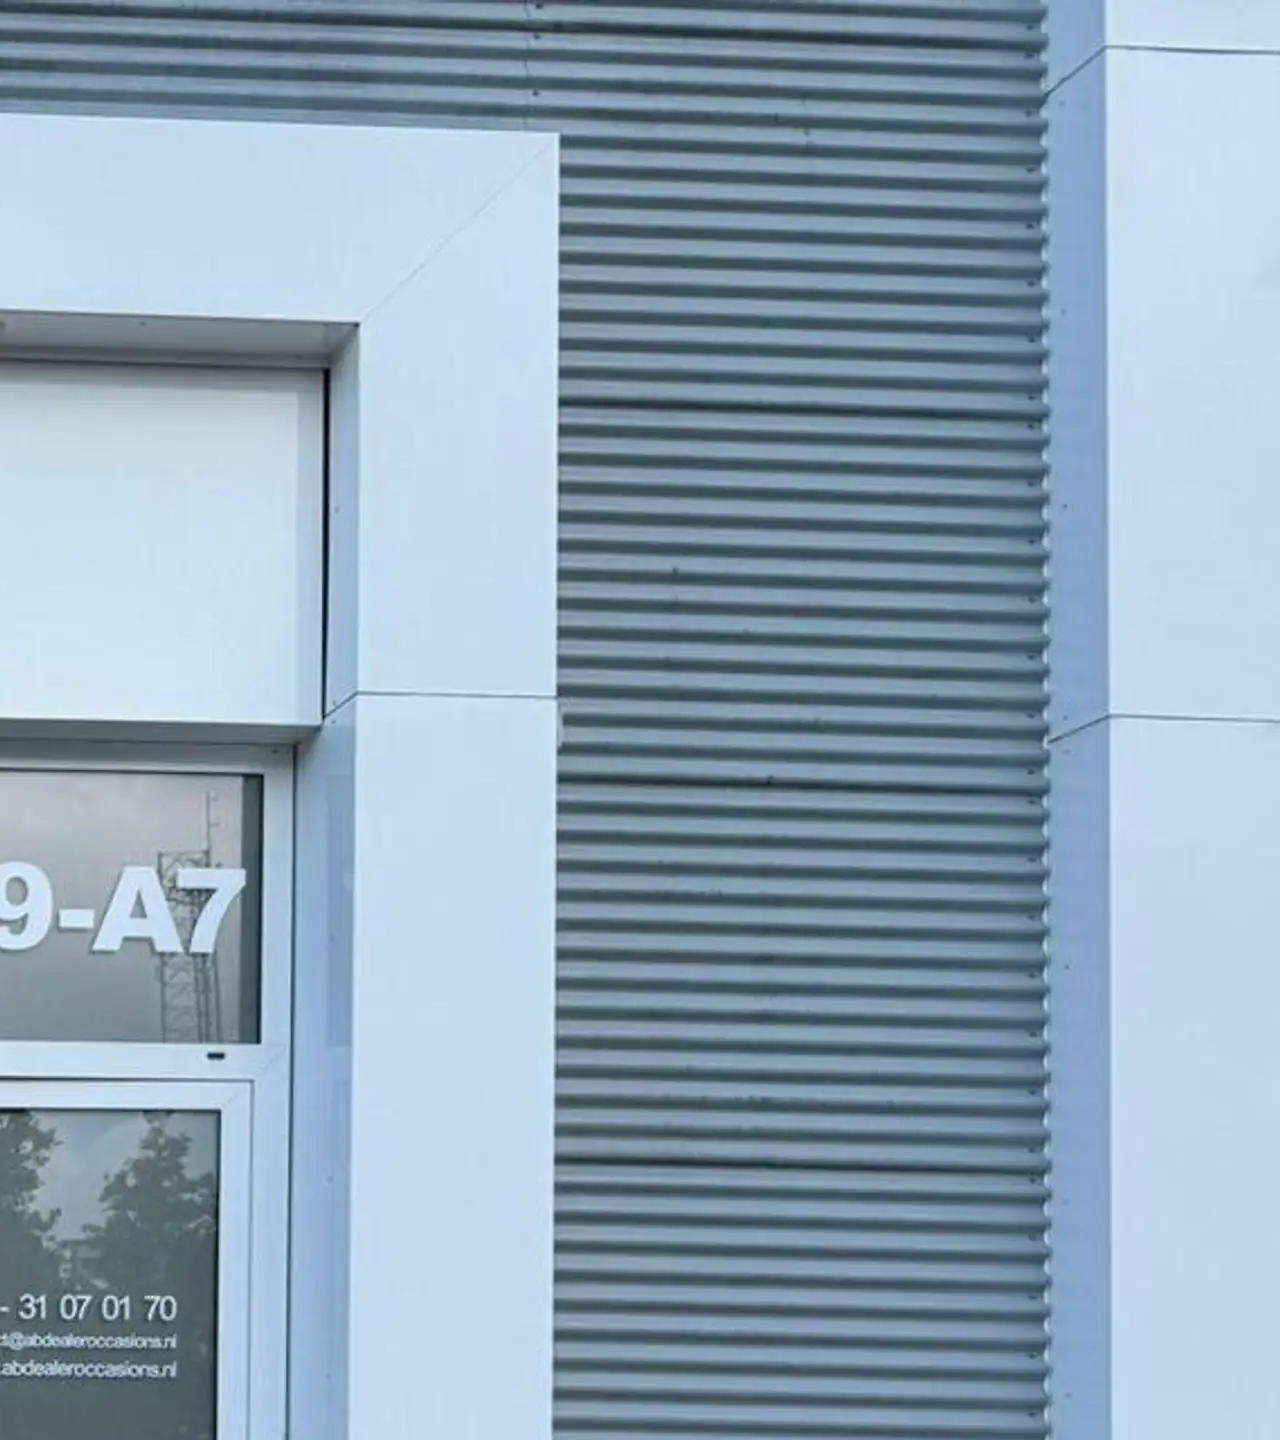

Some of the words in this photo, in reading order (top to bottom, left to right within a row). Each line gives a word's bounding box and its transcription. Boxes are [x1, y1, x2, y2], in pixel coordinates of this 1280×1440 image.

[18, 1294, 47, 1320] 31
[59, 1295, 93, 1321] 07
[101, 1296, 131, 1321] 01
[143, 1296, 178, 1322] 70
